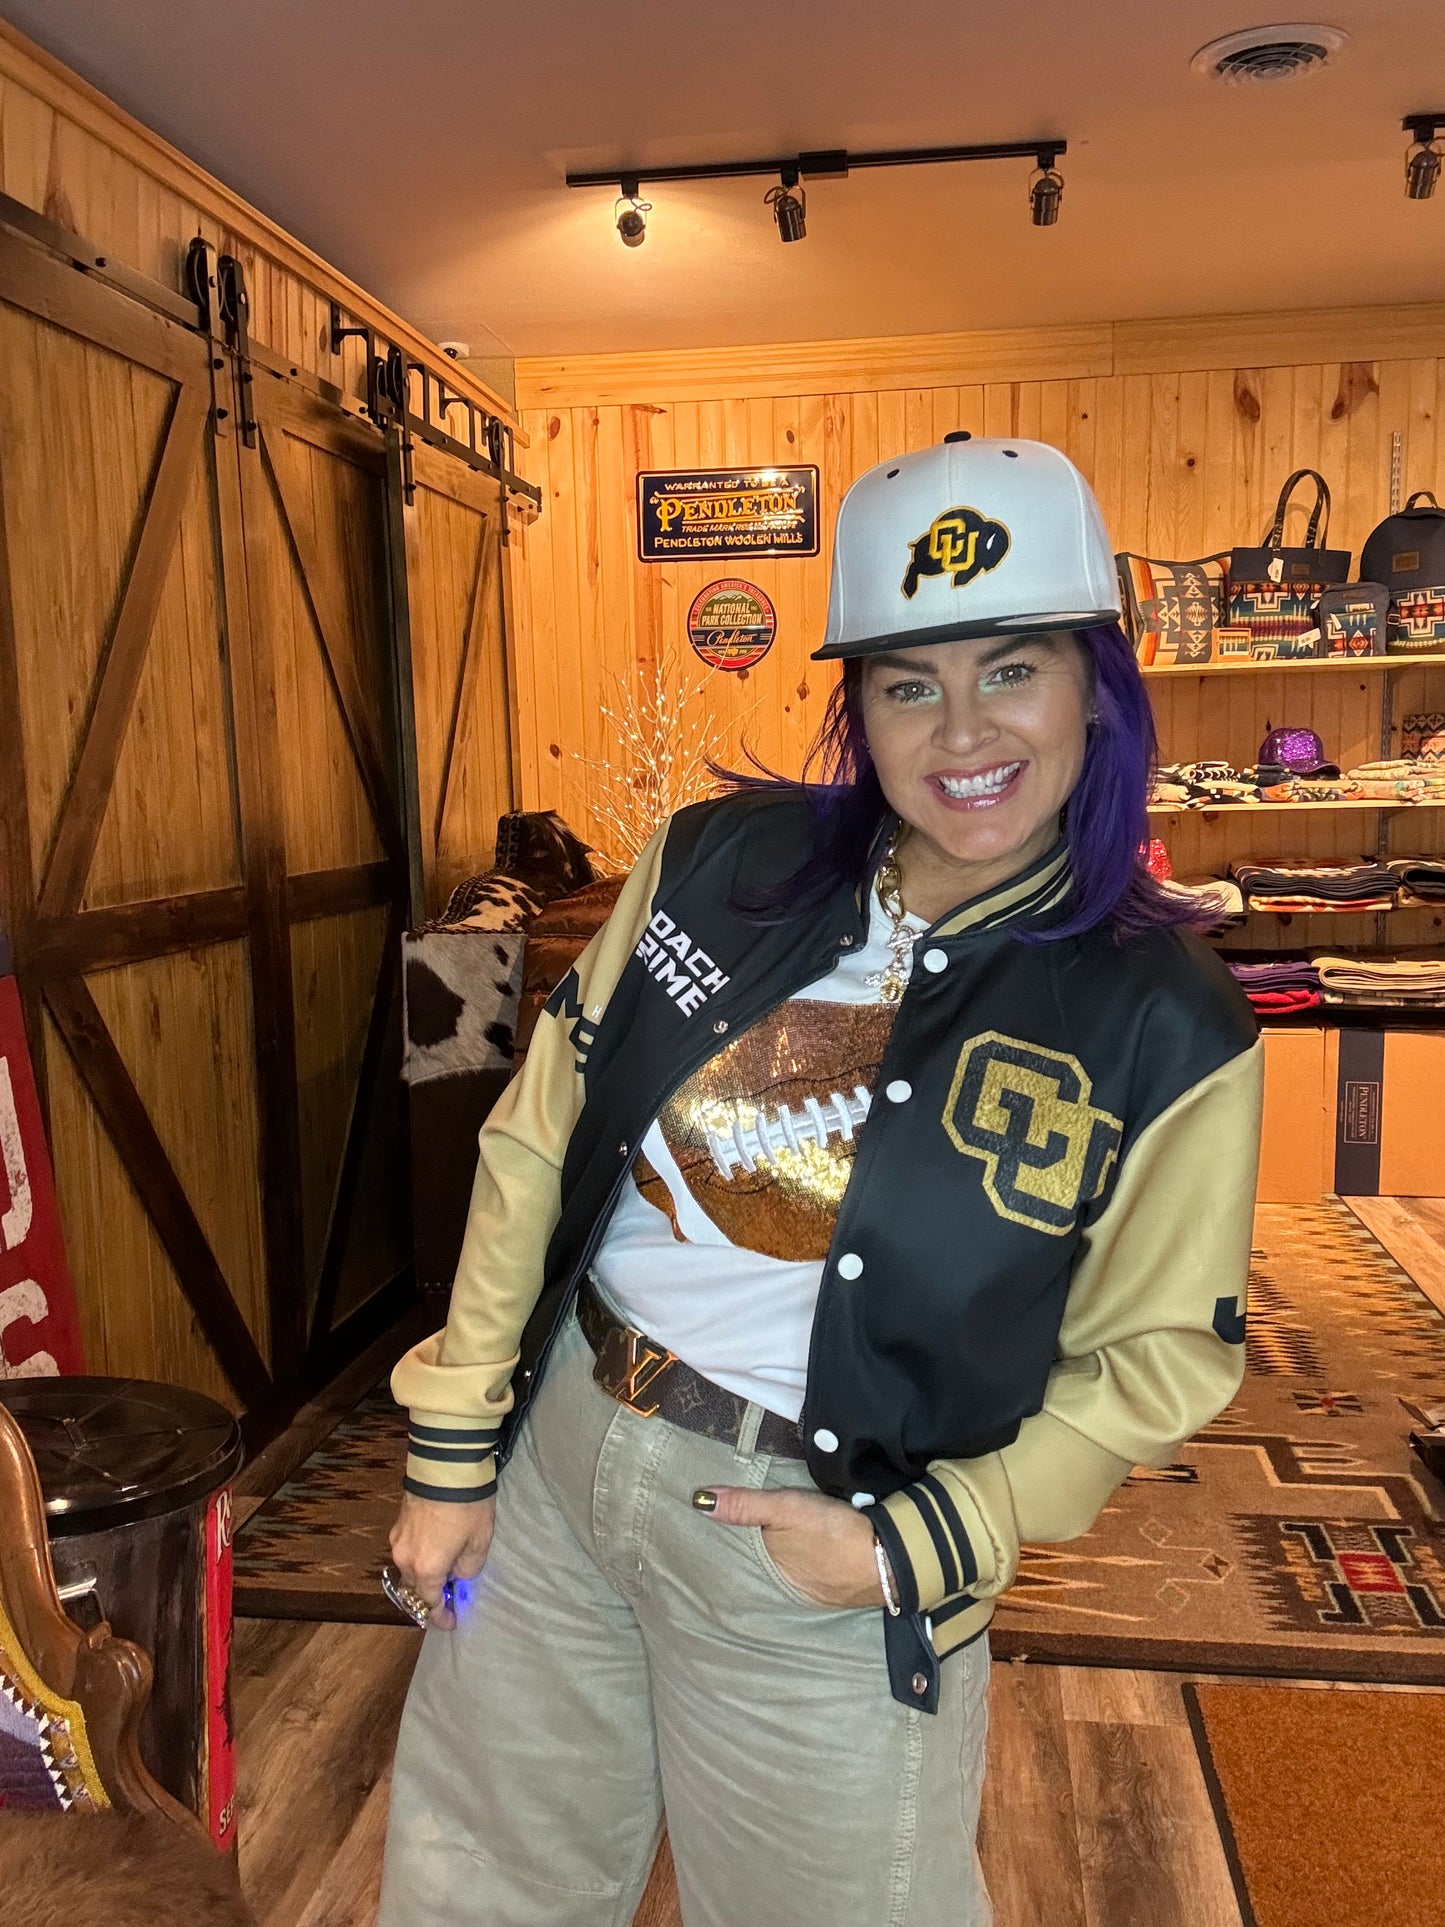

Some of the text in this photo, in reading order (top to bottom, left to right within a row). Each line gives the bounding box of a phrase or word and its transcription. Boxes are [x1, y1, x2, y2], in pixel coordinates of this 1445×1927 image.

[664, 480, 740, 491] WARRANTED
[682, 523, 709, 533] TRADE
[709, 522, 736, 532] MARK
[654, 531, 804, 549] PENDLETON WOOLEN MILLS
[928, 518, 980, 573] CU
[712, 602, 751, 615] NATIONAL
[701, 613, 763, 626] PARK COLLECTION
[706, 628, 758, 647] Pendleton
[1358, 1086, 1370, 1138] PENDLETON
